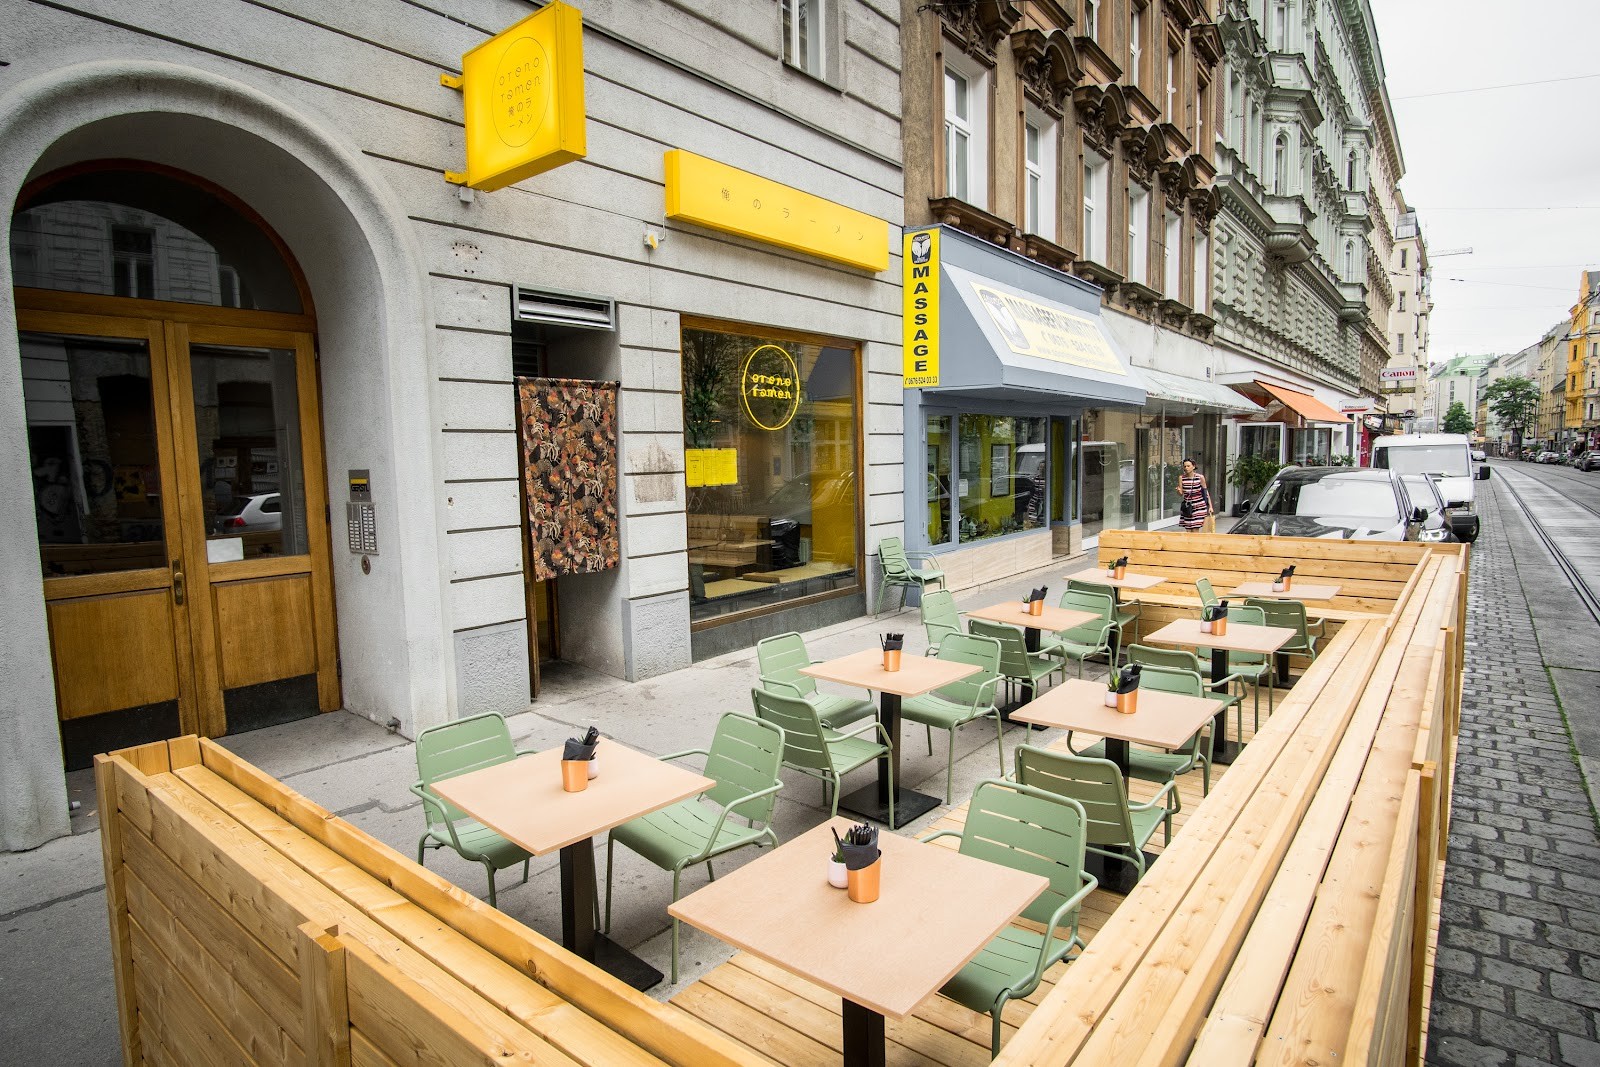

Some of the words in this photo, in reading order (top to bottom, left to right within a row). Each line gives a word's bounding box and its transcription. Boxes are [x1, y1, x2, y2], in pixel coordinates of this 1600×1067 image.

[499, 57, 540, 86] oreno
[500, 75, 541, 103] ramen
[912, 265, 930, 372] MASSAGE
[752, 373, 791, 387] oreno
[752, 388, 792, 399] ramen
